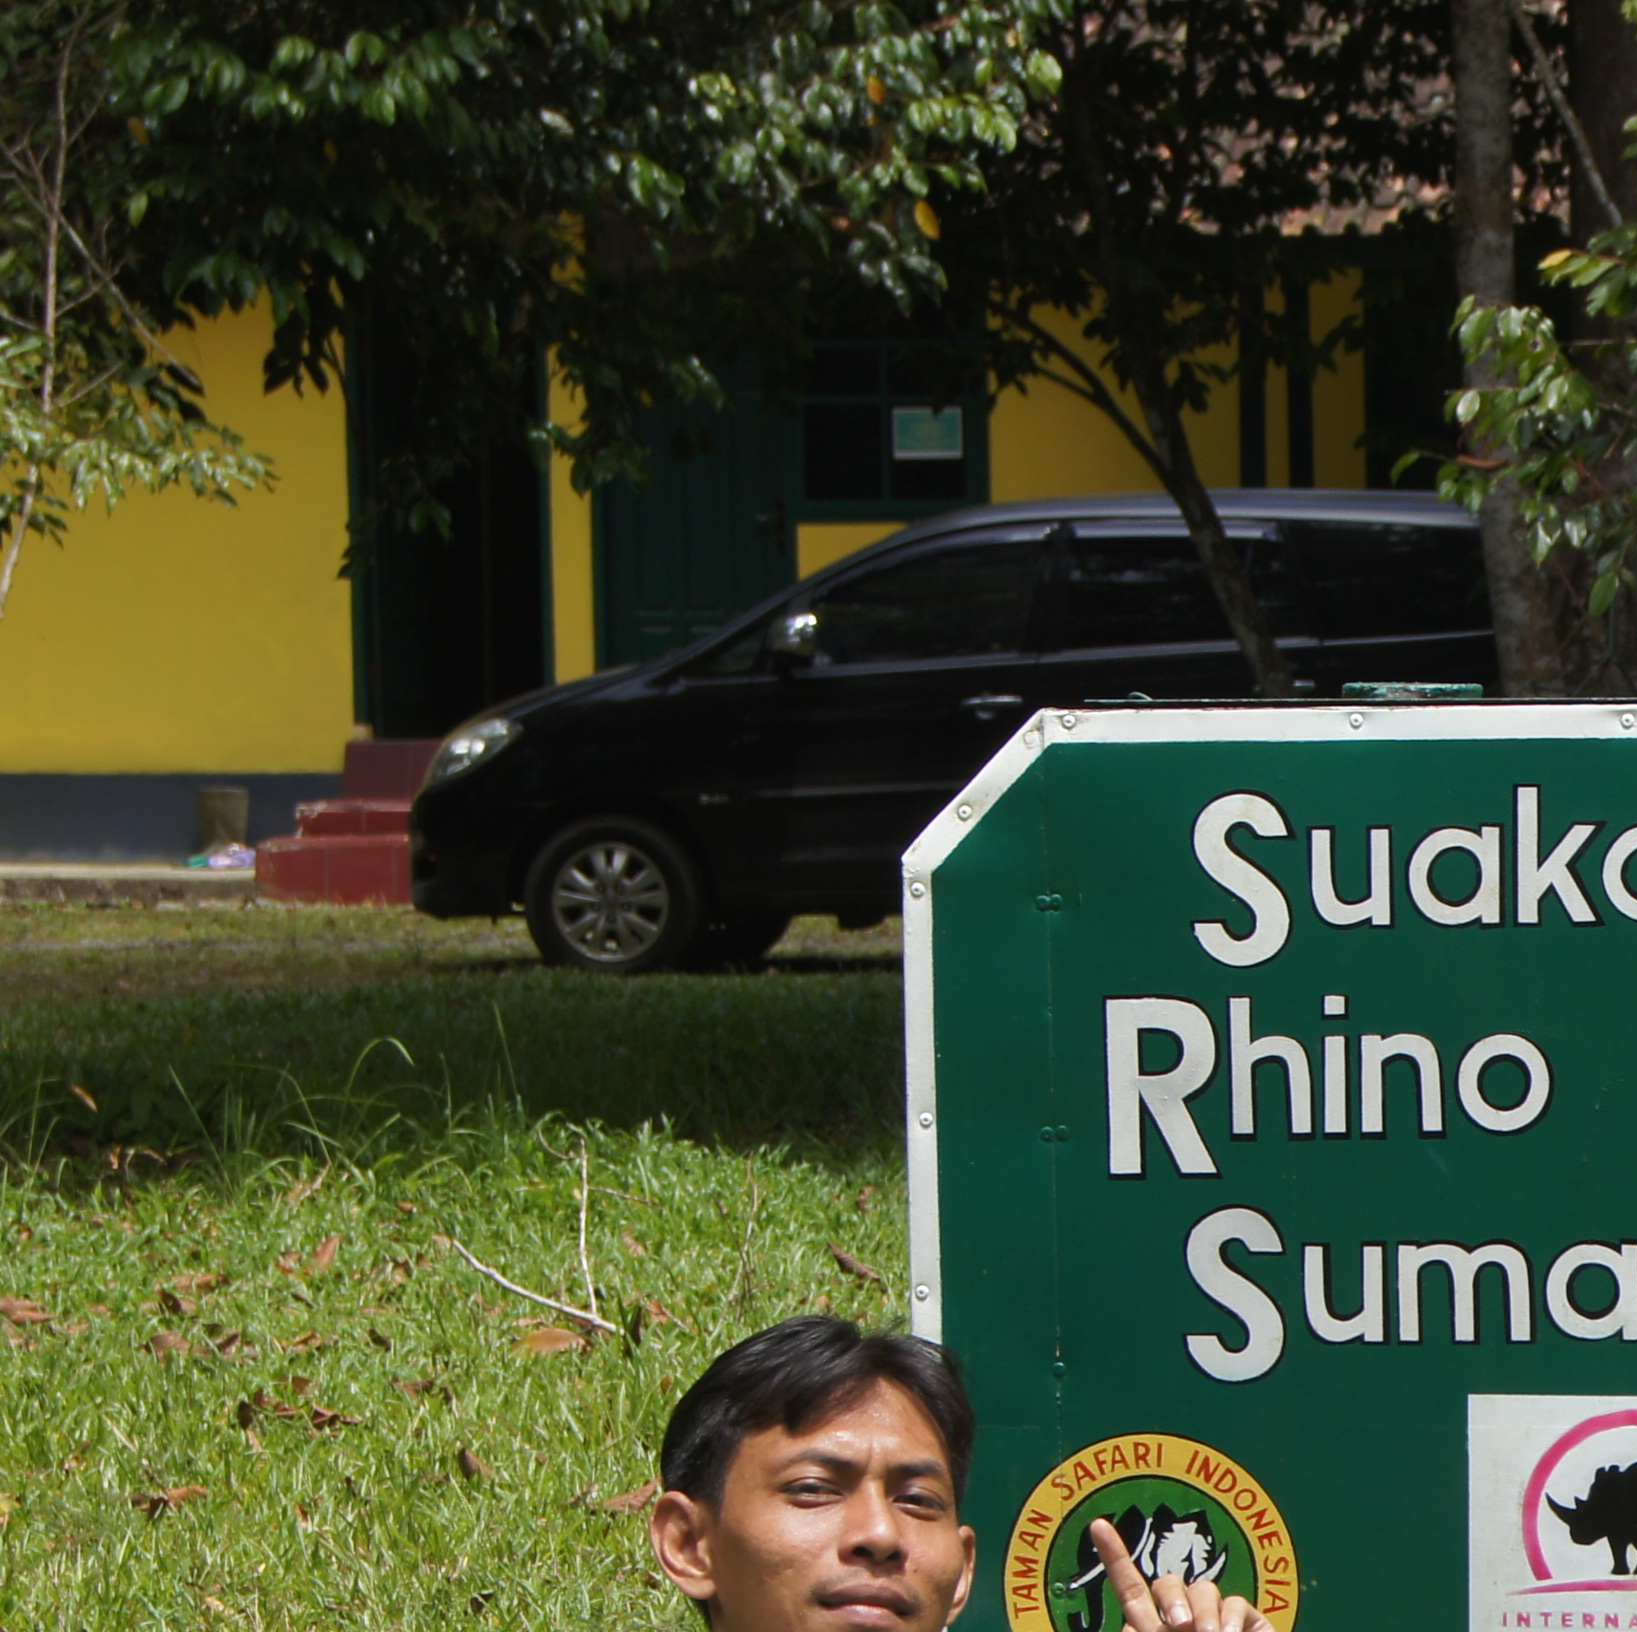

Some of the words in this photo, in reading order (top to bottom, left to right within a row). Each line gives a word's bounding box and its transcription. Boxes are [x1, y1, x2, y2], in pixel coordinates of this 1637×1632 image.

[1104, 992, 1551, 1177] Rhino
[1011, 1508, 1055, 1620] TAMAN
[1050, 1441, 1165, 1502] SAFARI
[1183, 1449, 1292, 1615] INDONESIA
